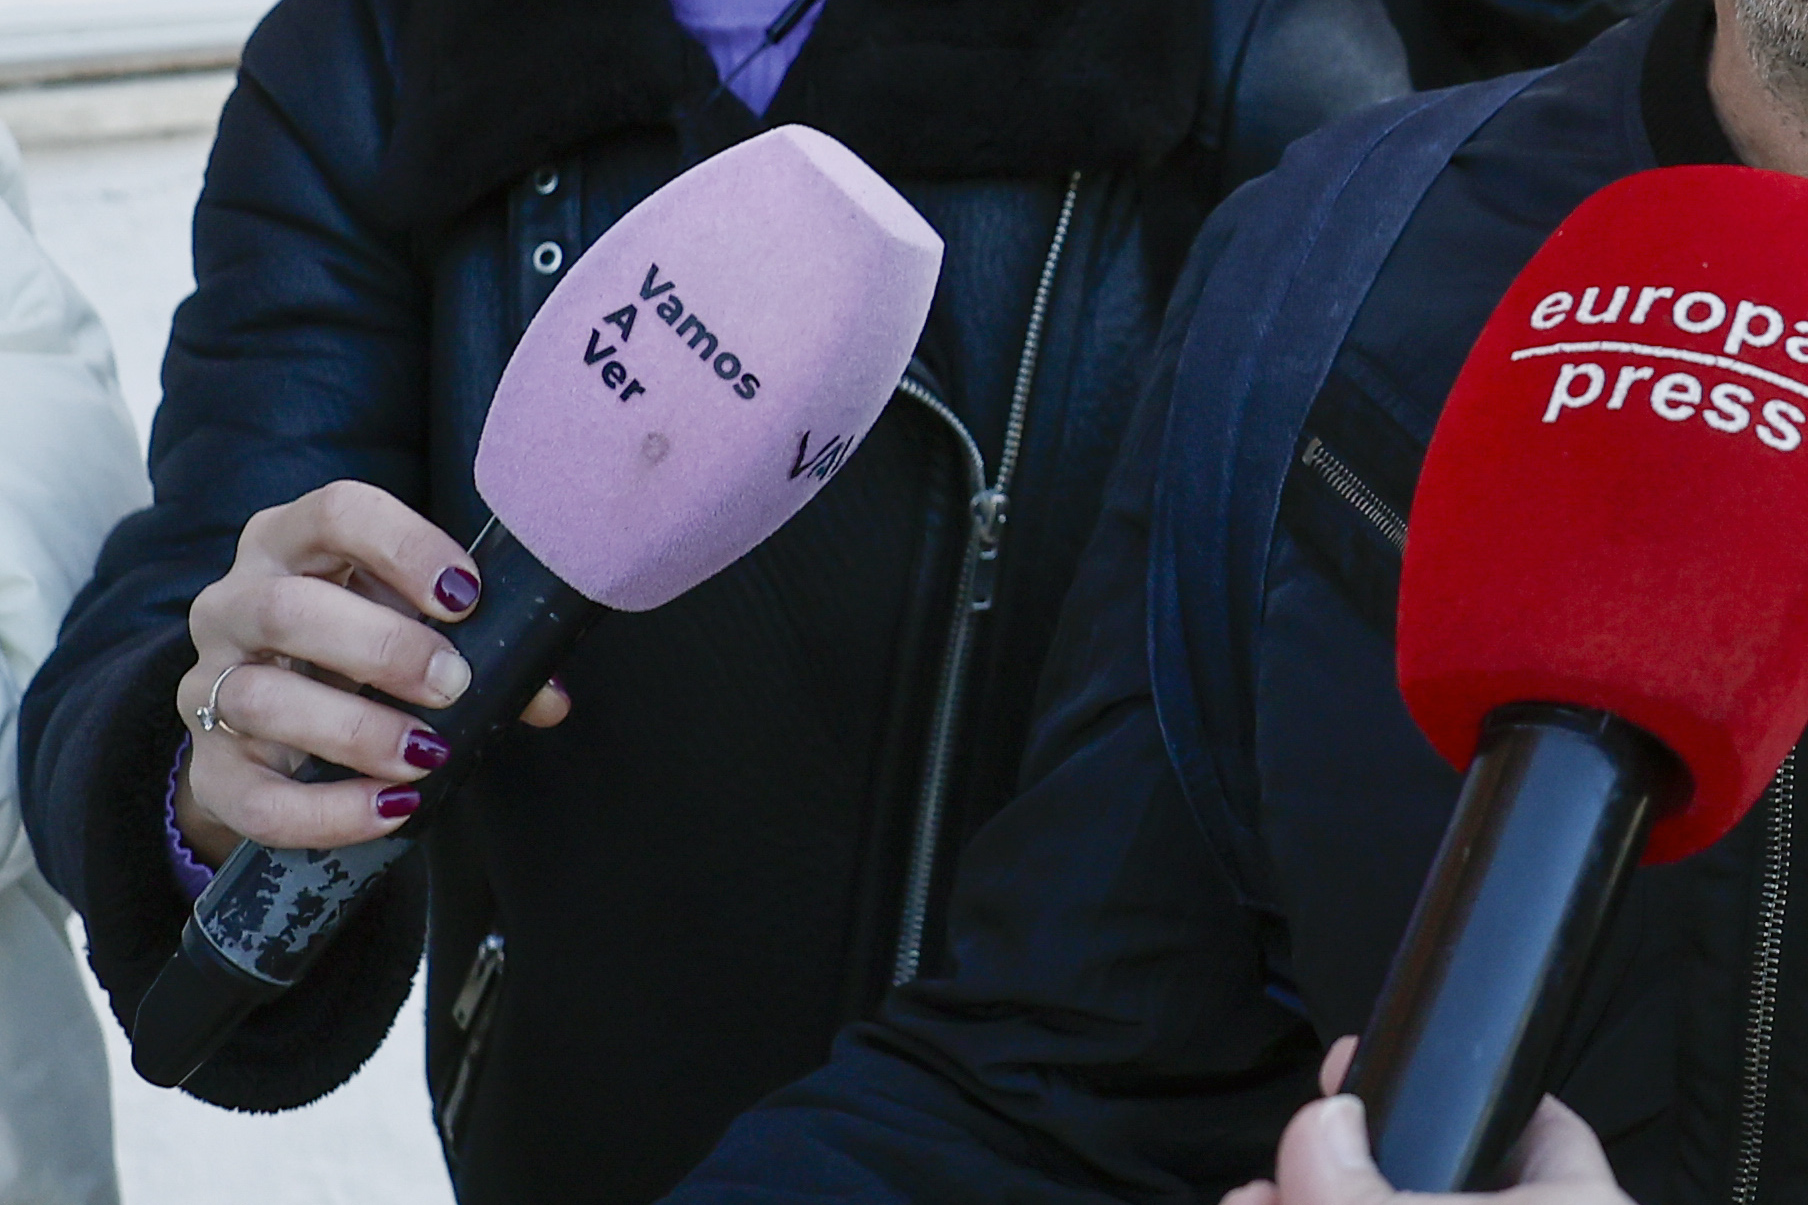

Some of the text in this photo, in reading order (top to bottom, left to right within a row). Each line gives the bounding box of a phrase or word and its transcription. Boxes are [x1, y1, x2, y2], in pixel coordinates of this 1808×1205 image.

[602, 303, 638, 342] A
[639, 262, 761, 400] Vamos
[583, 327, 647, 403] Ver
[1541, 362, 1806, 452] press
